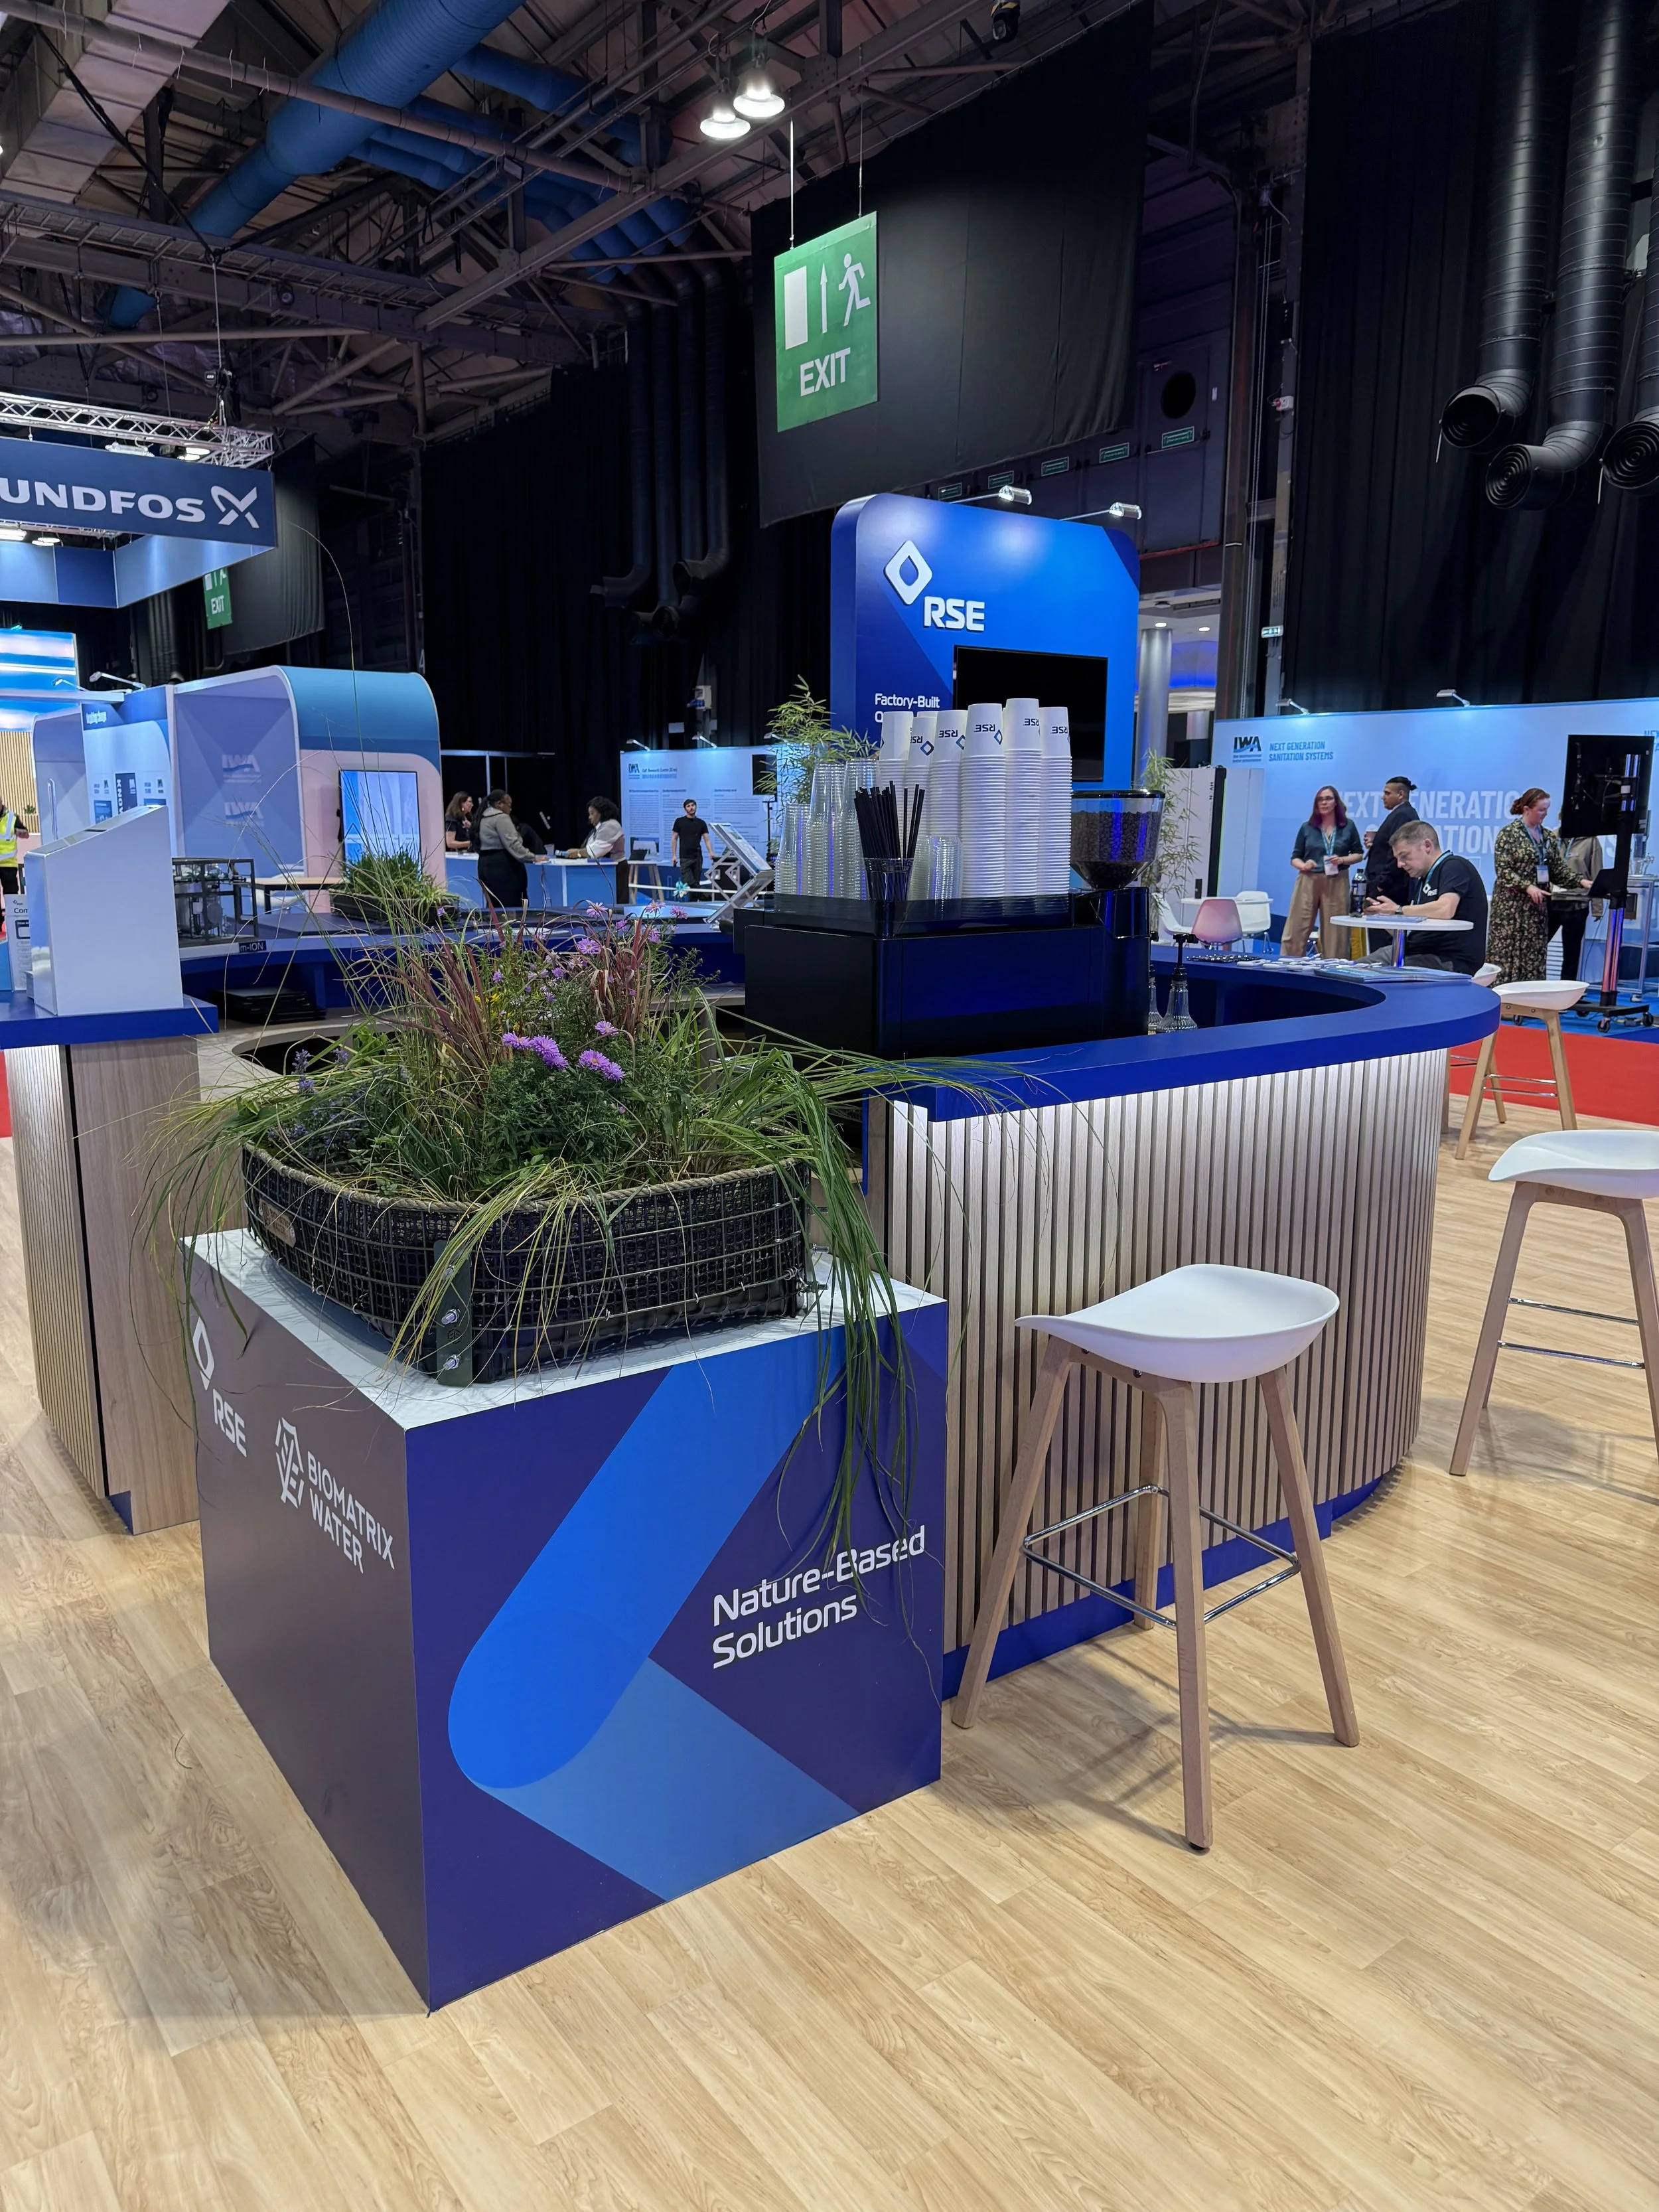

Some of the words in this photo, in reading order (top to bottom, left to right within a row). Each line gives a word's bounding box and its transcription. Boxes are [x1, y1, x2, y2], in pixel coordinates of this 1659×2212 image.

[800, 346, 851, 397] EXIT
[0, 477, 206, 523] UNDFOS
[210, 595, 224, 615] EXIT
[923, 595, 985, 632] RSE
[875, 693, 940, 709] Factory-Built
[1234, 736, 1262, 753] IWA
[1268, 752, 1304, 762] SANITATION
[1305, 752, 1334, 761] SYSTEMS
[1269, 743, 1285, 751] NEXT
[1287, 741, 1325, 751] GENERATION
[222, 754, 261, 773] IWA
[1340, 790, 1382, 818] EXT
[1409, 790, 1520, 820] ENERATIO
[240, 942, 264, 952] m-ION
[212, 1388, 248, 1457] RSE
[307, 1450, 396, 1570] BIOMATRIX
[309, 1488, 364, 1574] WATER
[713, 1524, 926, 1627] Nature-Based
[713, 1594, 858, 1669] Solutions
